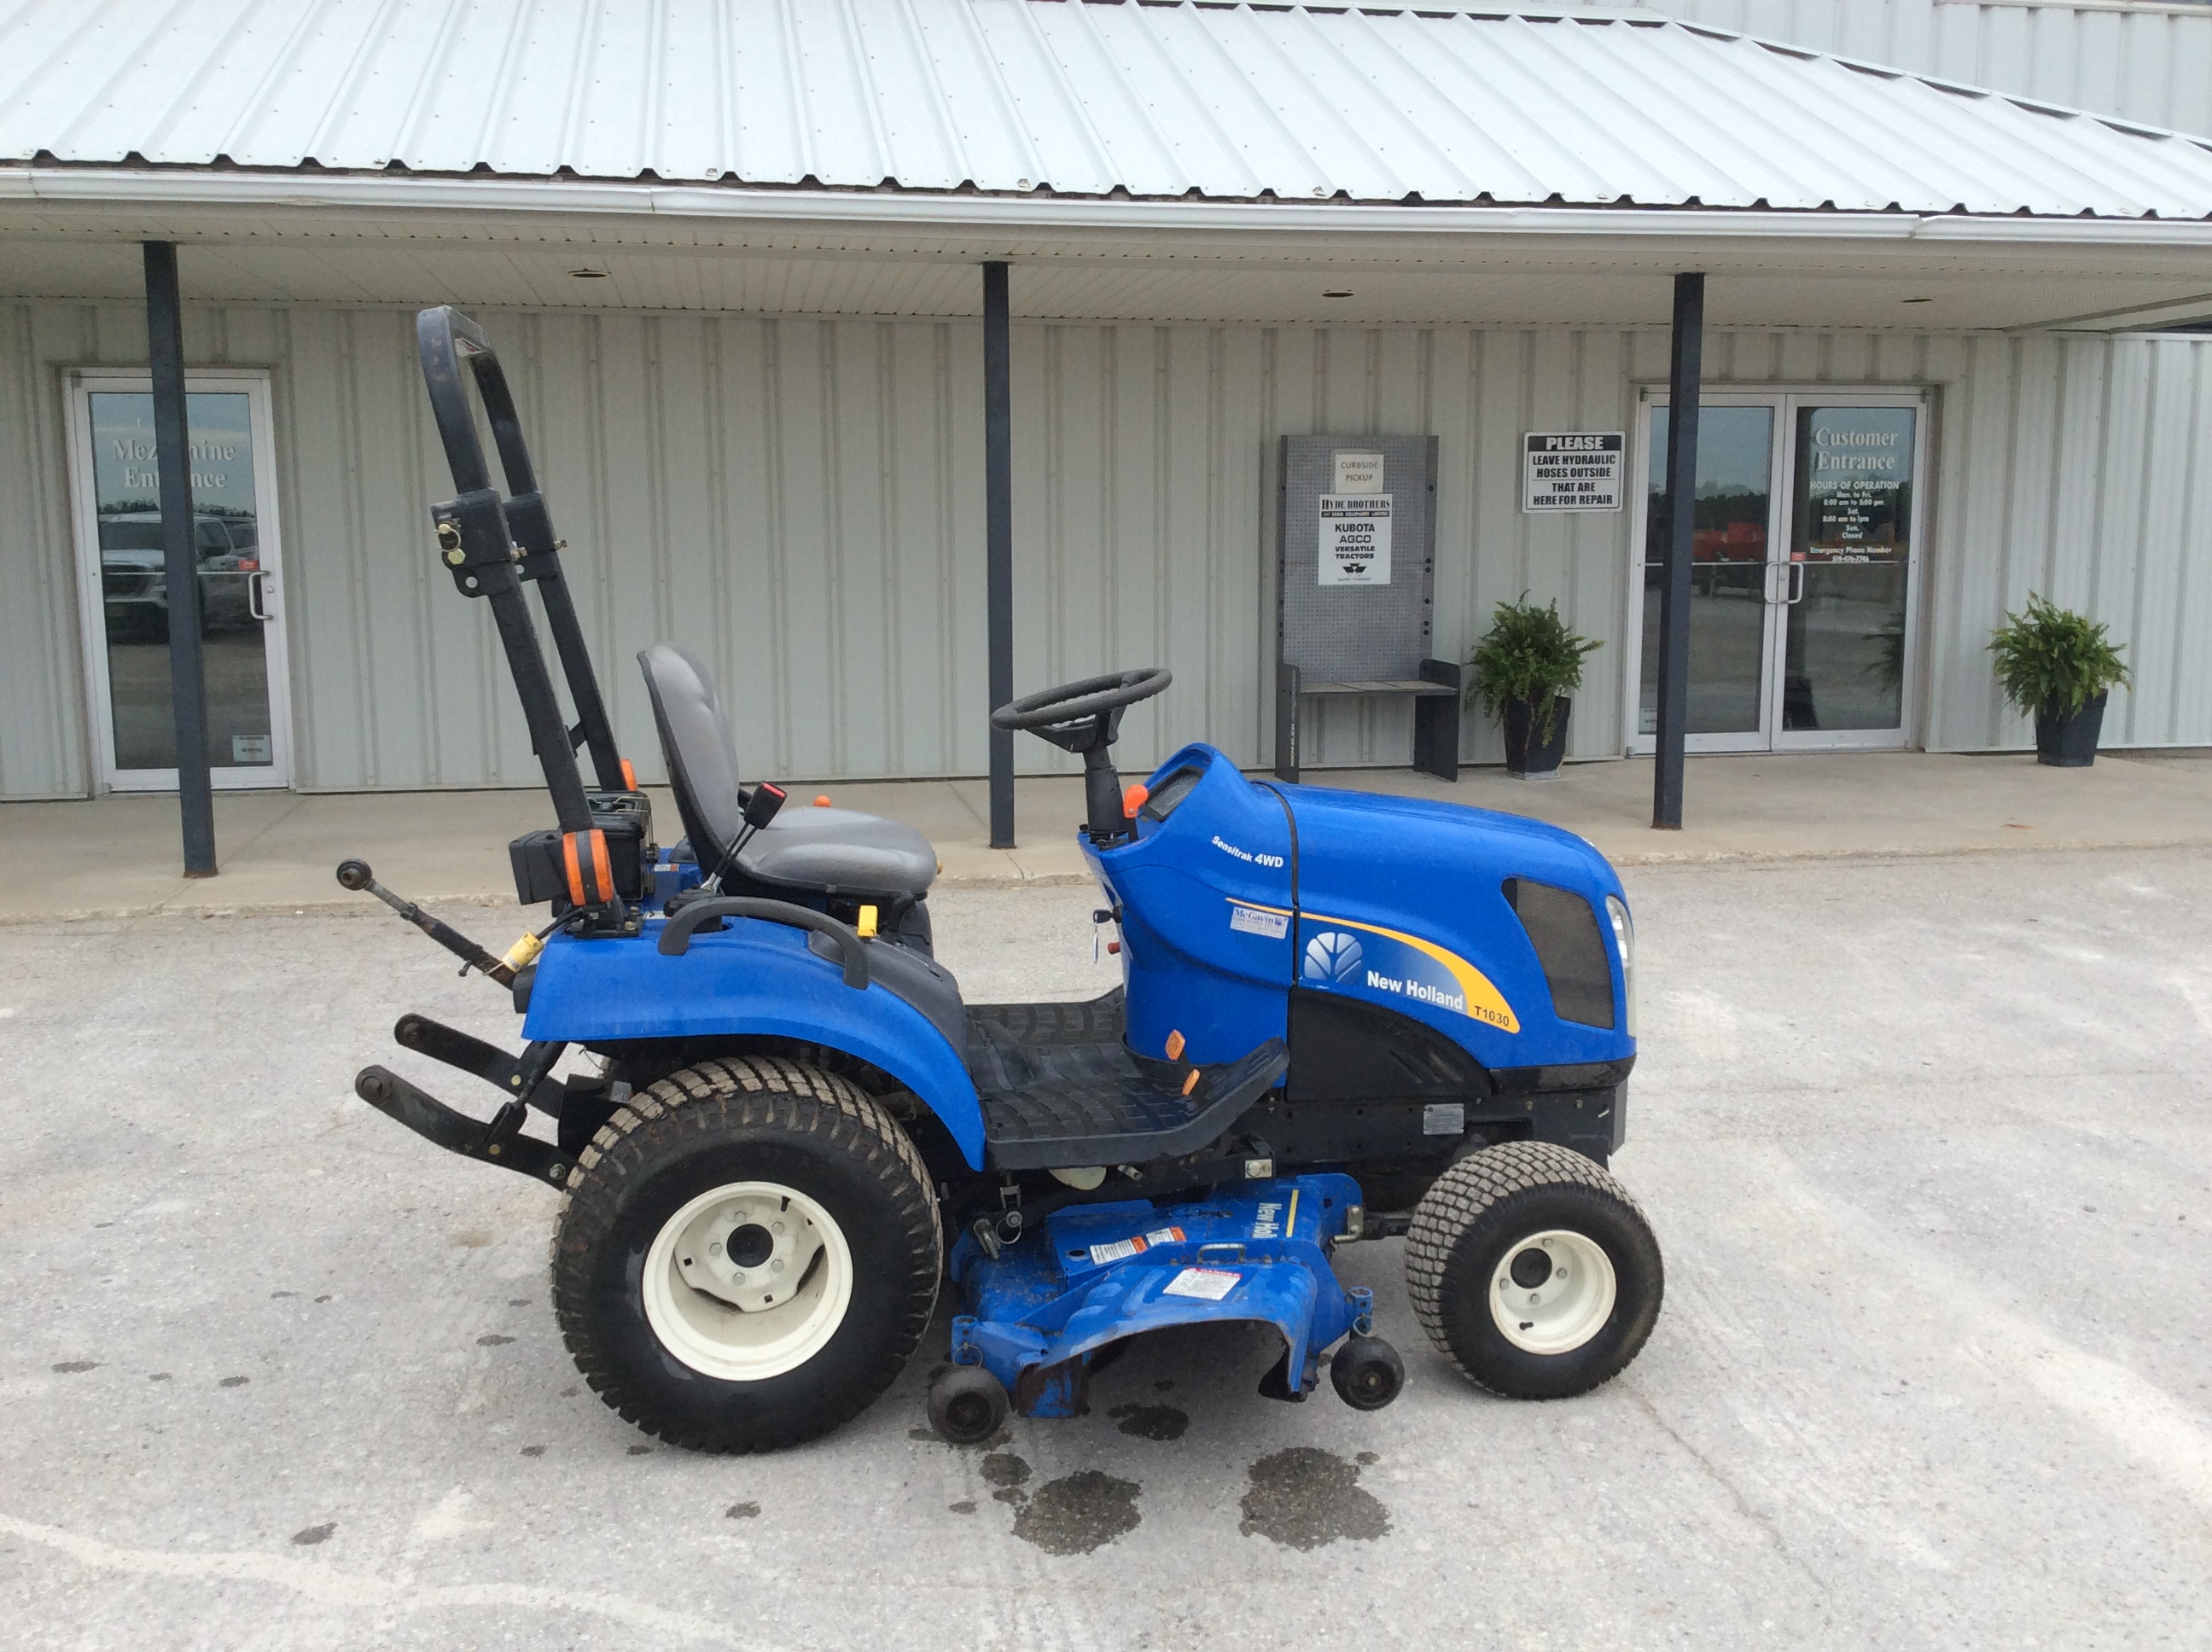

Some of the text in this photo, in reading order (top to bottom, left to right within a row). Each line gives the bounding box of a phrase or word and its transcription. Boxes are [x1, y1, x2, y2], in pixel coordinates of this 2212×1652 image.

[1815, 427, 1898, 446] Customer
[1545, 436, 1604, 451] PLEASE
[113, 439, 236, 461] Meznine
[1533, 455, 1615, 465] LEAVE HYDRAULIC
[1817, 451, 1895, 471] Entrance
[124, 467, 227, 488] Entnce
[1345, 474, 1374, 482] PICKUP
[1536, 468, 1611, 478] HOSES OUTSIDE
[1551, 482, 1596, 492] THAT ARE
[1810, 480, 1900, 489] HOURS OF OPERATION
[1322, 499, 1390, 509] HYDE BROTHERS
[1533, 495, 1613, 505] HERE FOR REPAIR
[1335, 523, 1375, 532] KUBOTA
[1339, 535, 1371, 544] AGCO
[1212, 835, 1284, 868] Sensitrak 4WD
[1367, 970, 1464, 1010] New Holland
[1474, 1005, 1510, 1027] T1030
[1256, 1202, 1283, 1222] New
